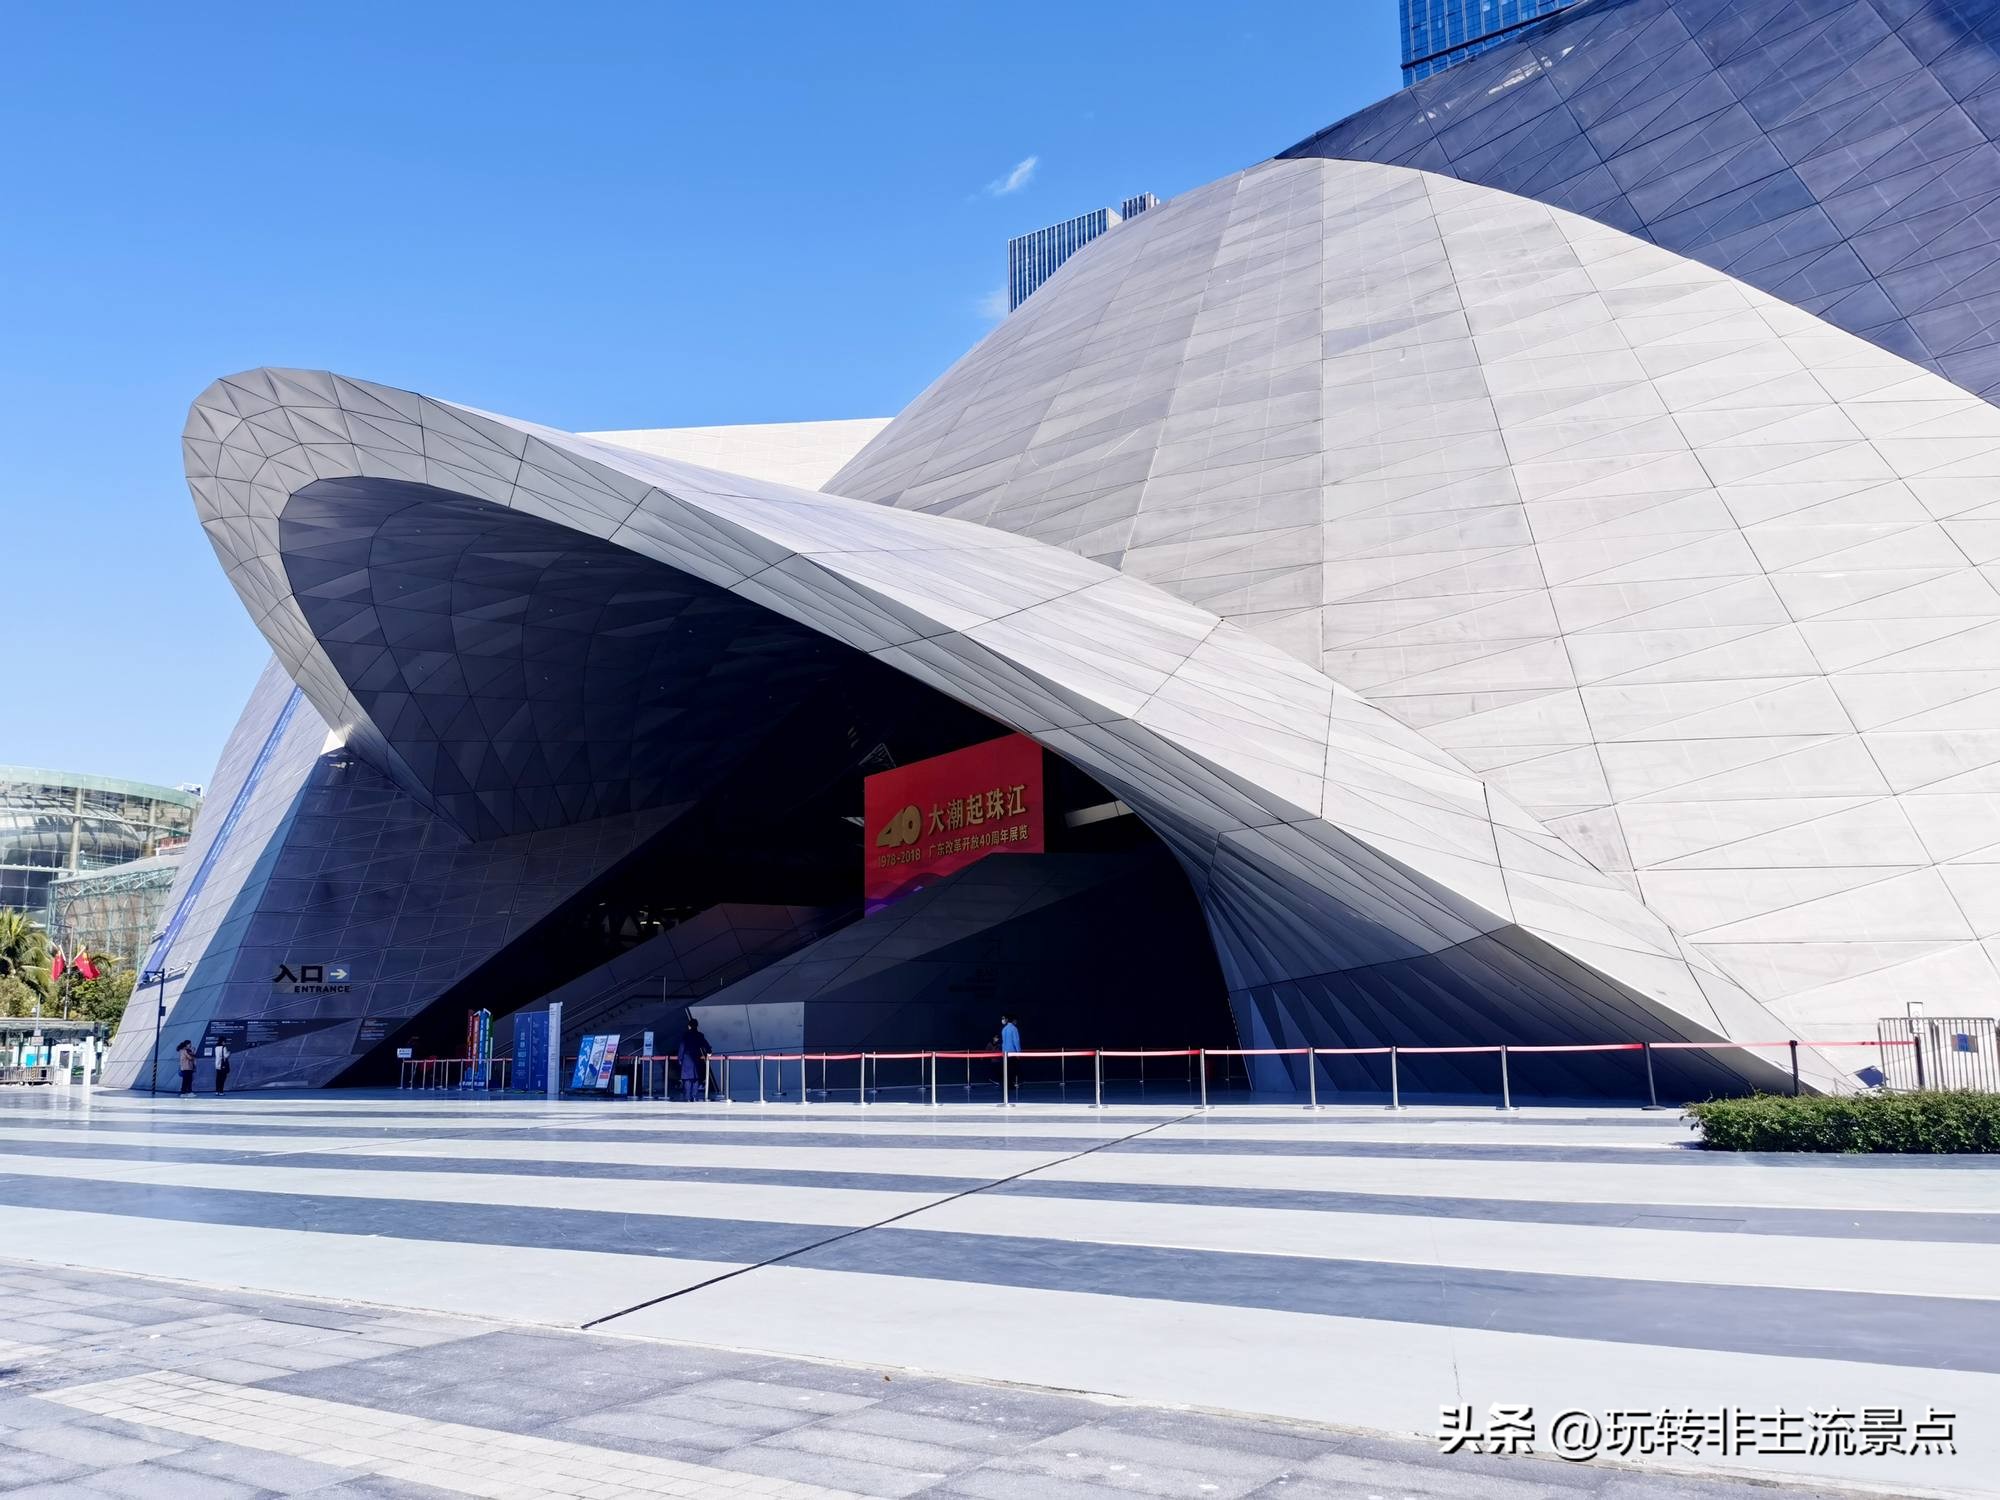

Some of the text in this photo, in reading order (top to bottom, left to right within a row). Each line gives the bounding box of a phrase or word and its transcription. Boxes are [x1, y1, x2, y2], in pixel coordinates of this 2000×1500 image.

[928, 784, 1027, 835] 大潮起珠江
[876, 805, 921, 847] 40
[929, 825, 1029, 857] 广东改革开放40周年展览
[878, 849, 921, 868] 1978-2018
[273, 964, 323, 983] 入口
[294, 985, 351, 993] ENTRANCE
